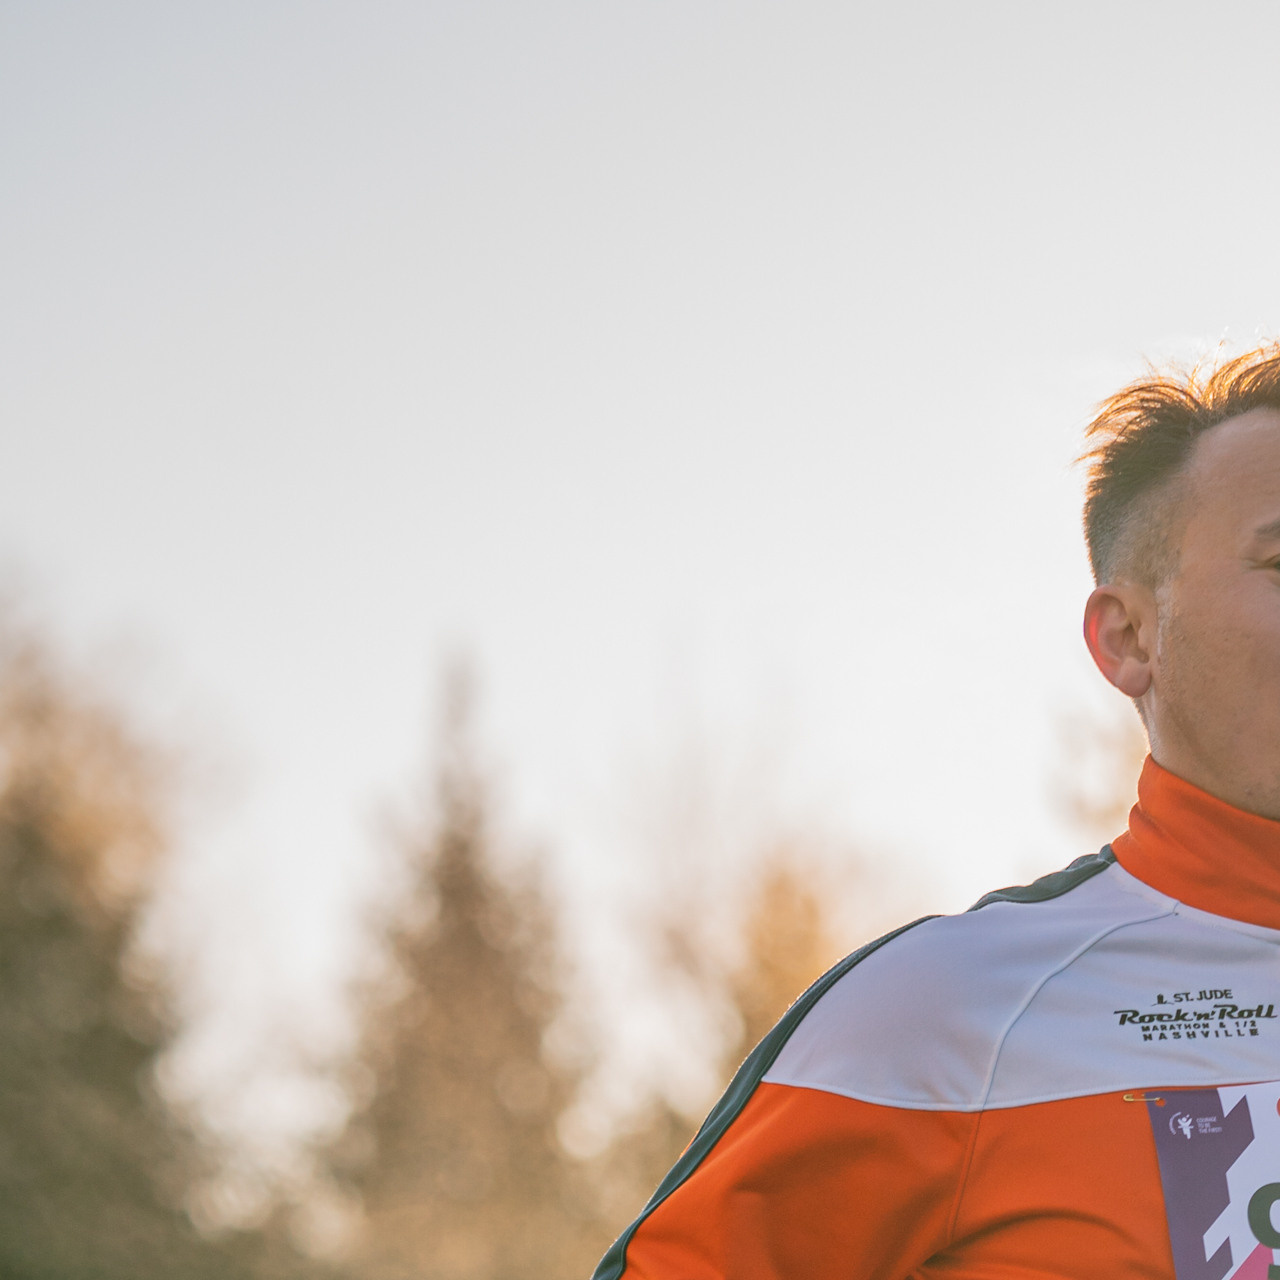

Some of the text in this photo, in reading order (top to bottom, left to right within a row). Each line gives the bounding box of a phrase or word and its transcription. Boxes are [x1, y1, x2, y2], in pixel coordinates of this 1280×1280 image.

[1173, 989, 1233, 1003] ST. JUDE
[1141, 1020, 1257, 1033] MARATHON & 1/2
[1142, 1028, 1260, 1042] NASHVILLE
